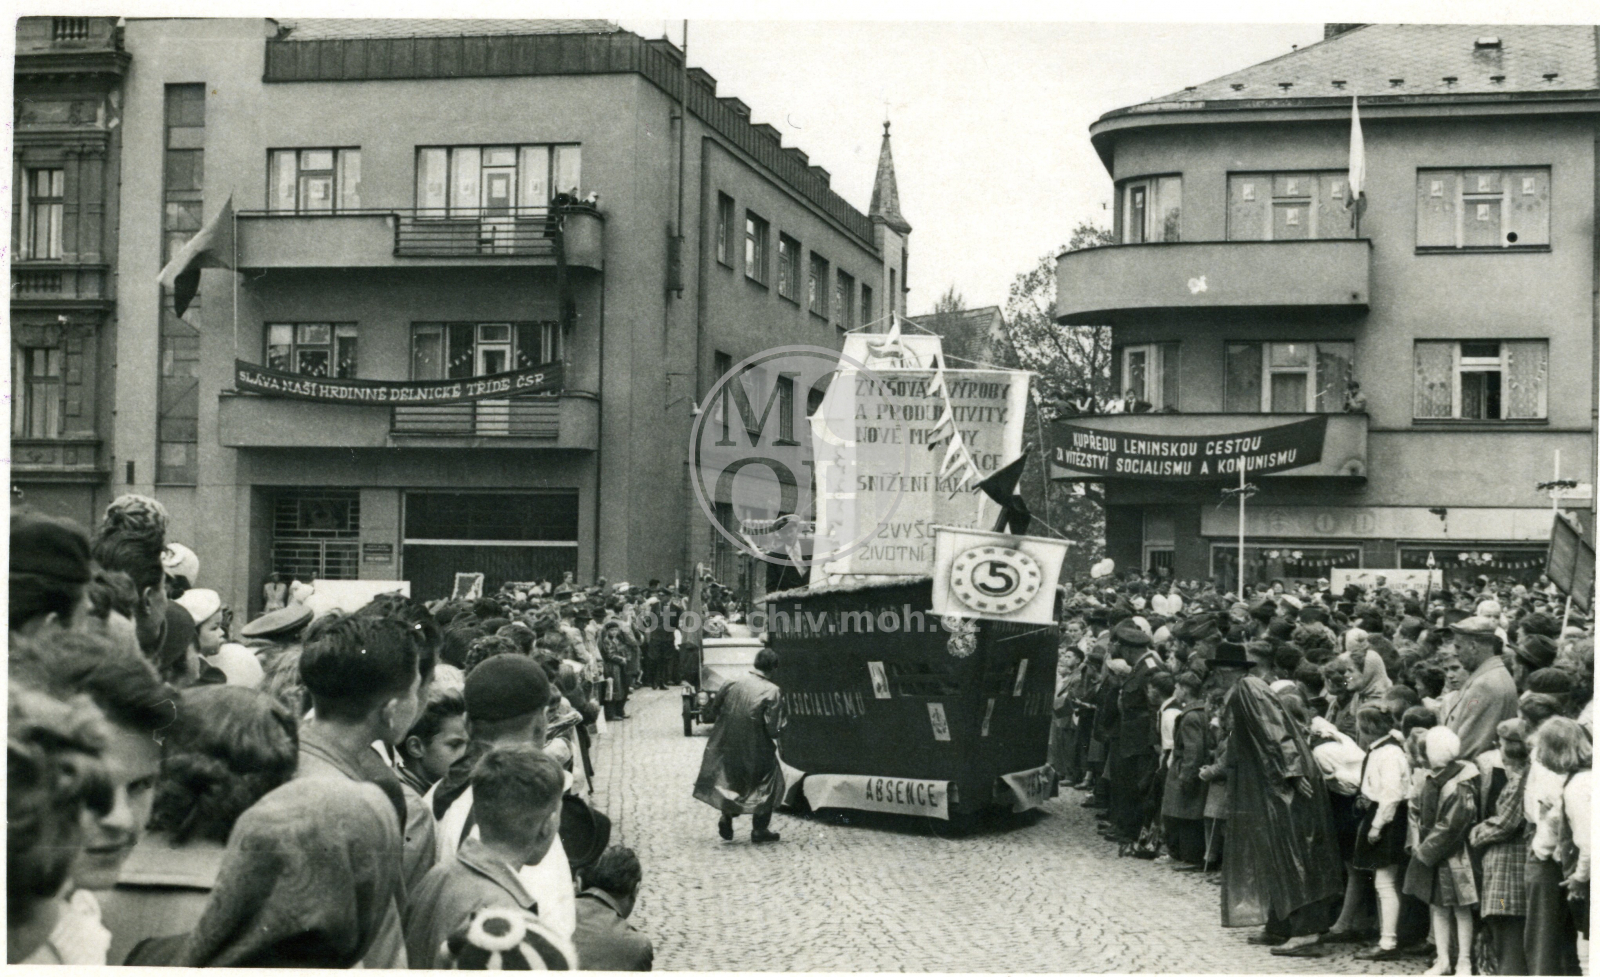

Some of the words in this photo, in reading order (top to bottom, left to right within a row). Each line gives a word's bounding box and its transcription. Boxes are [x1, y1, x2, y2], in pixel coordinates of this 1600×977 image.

[516, 373, 545, 388] ČSR
[855, 404, 868, 420] A
[1073, 431, 1116, 452] KUPŘEDU
[1124, 439, 1197, 457] LENINSKOU
[1206, 436, 1262, 456] CESTOU
[1056, 447, 1064, 461] ZA
[1116, 458, 1192, 476] SOCIALISMU
[1201, 461, 1209, 475] A
[1218, 448, 1297, 474] KOMUNISMU
[979, 561, 1013, 593] 5
[866, 778, 938, 808] ABSENCE
